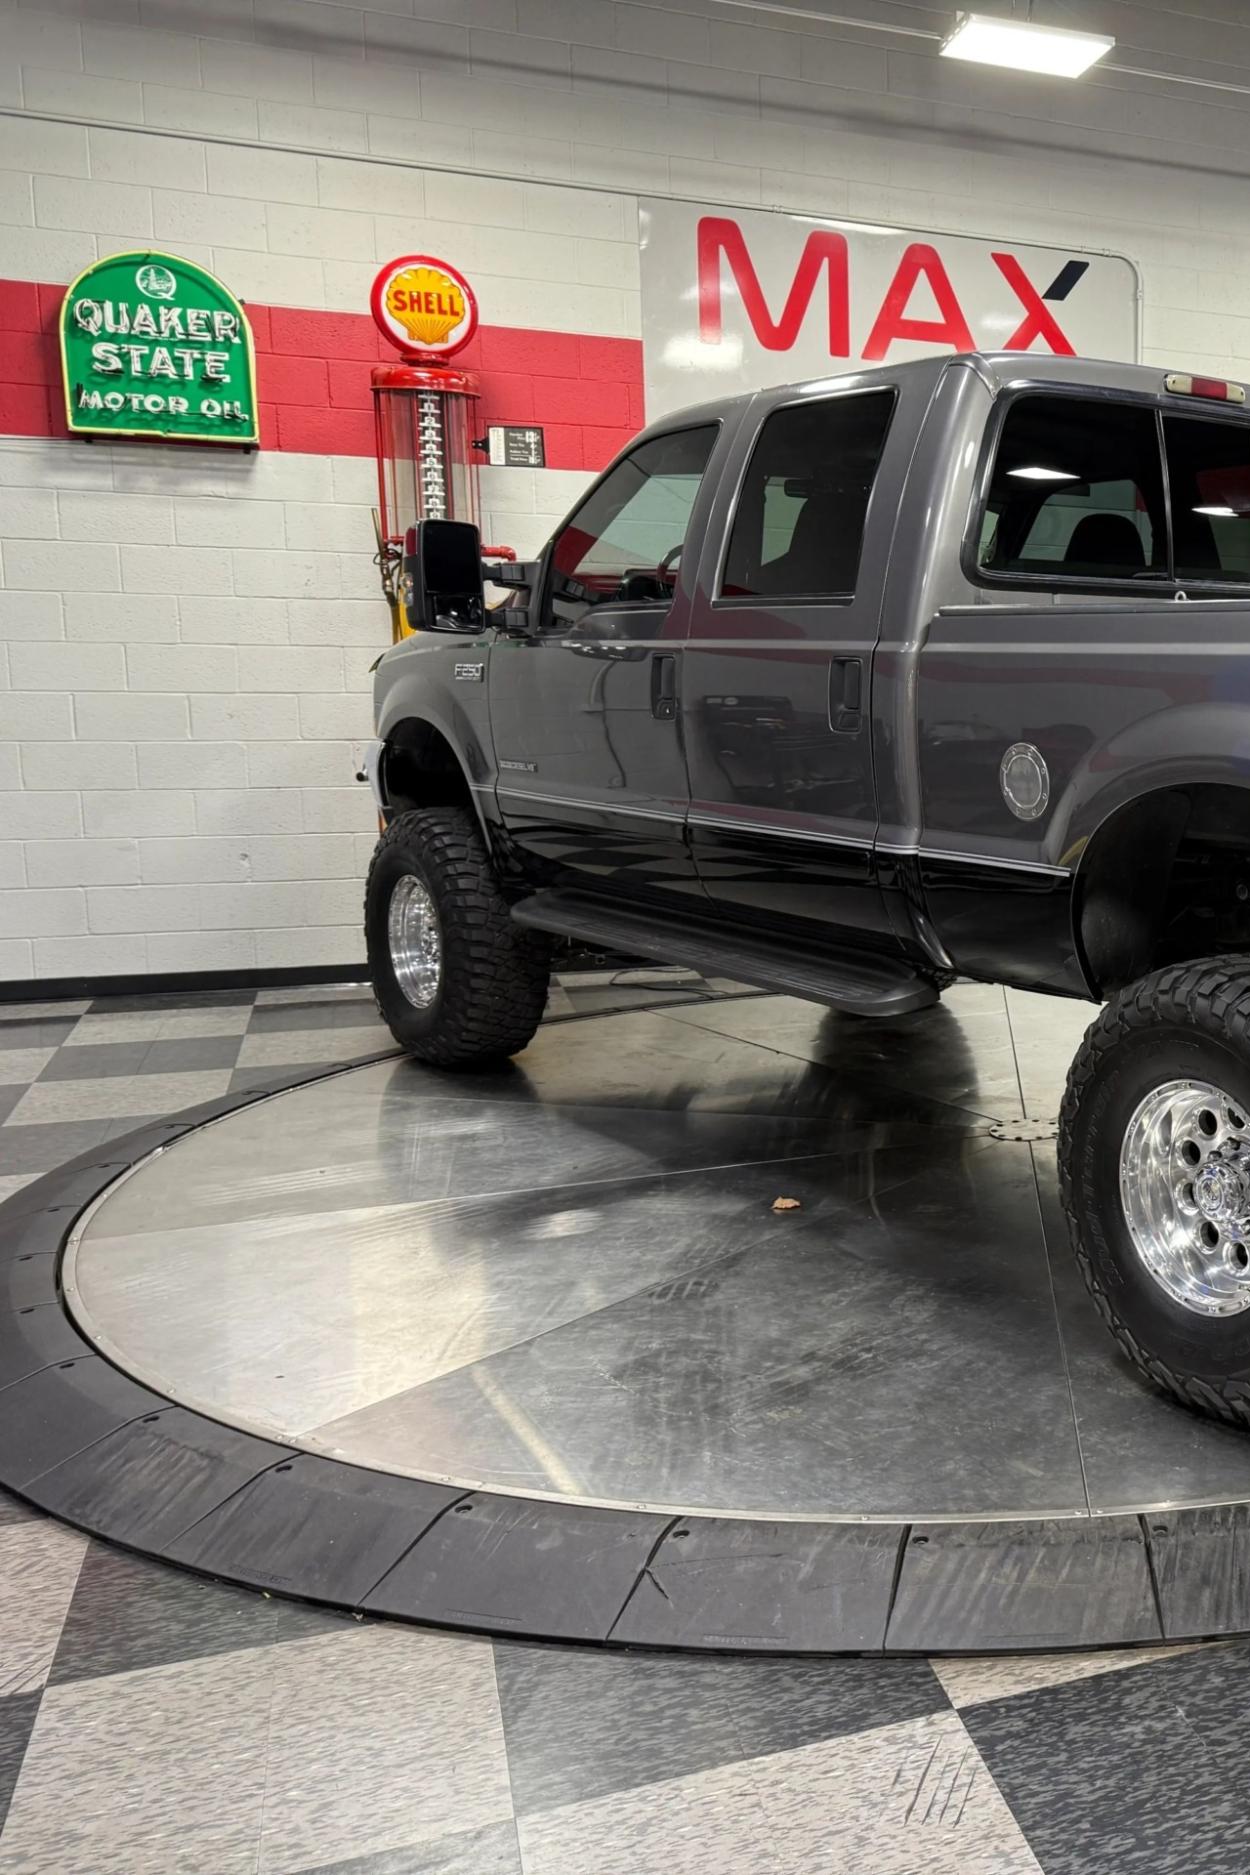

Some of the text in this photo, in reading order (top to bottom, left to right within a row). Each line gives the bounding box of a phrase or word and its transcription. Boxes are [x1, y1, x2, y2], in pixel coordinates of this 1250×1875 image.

[393, 289, 460, 317] SHELL
[697, 216, 1090, 361] MAX
[73, 298, 242, 344] QUAKER
[91, 342, 232, 384] STATE
[78, 389, 249, 422] MOTOR OIL
